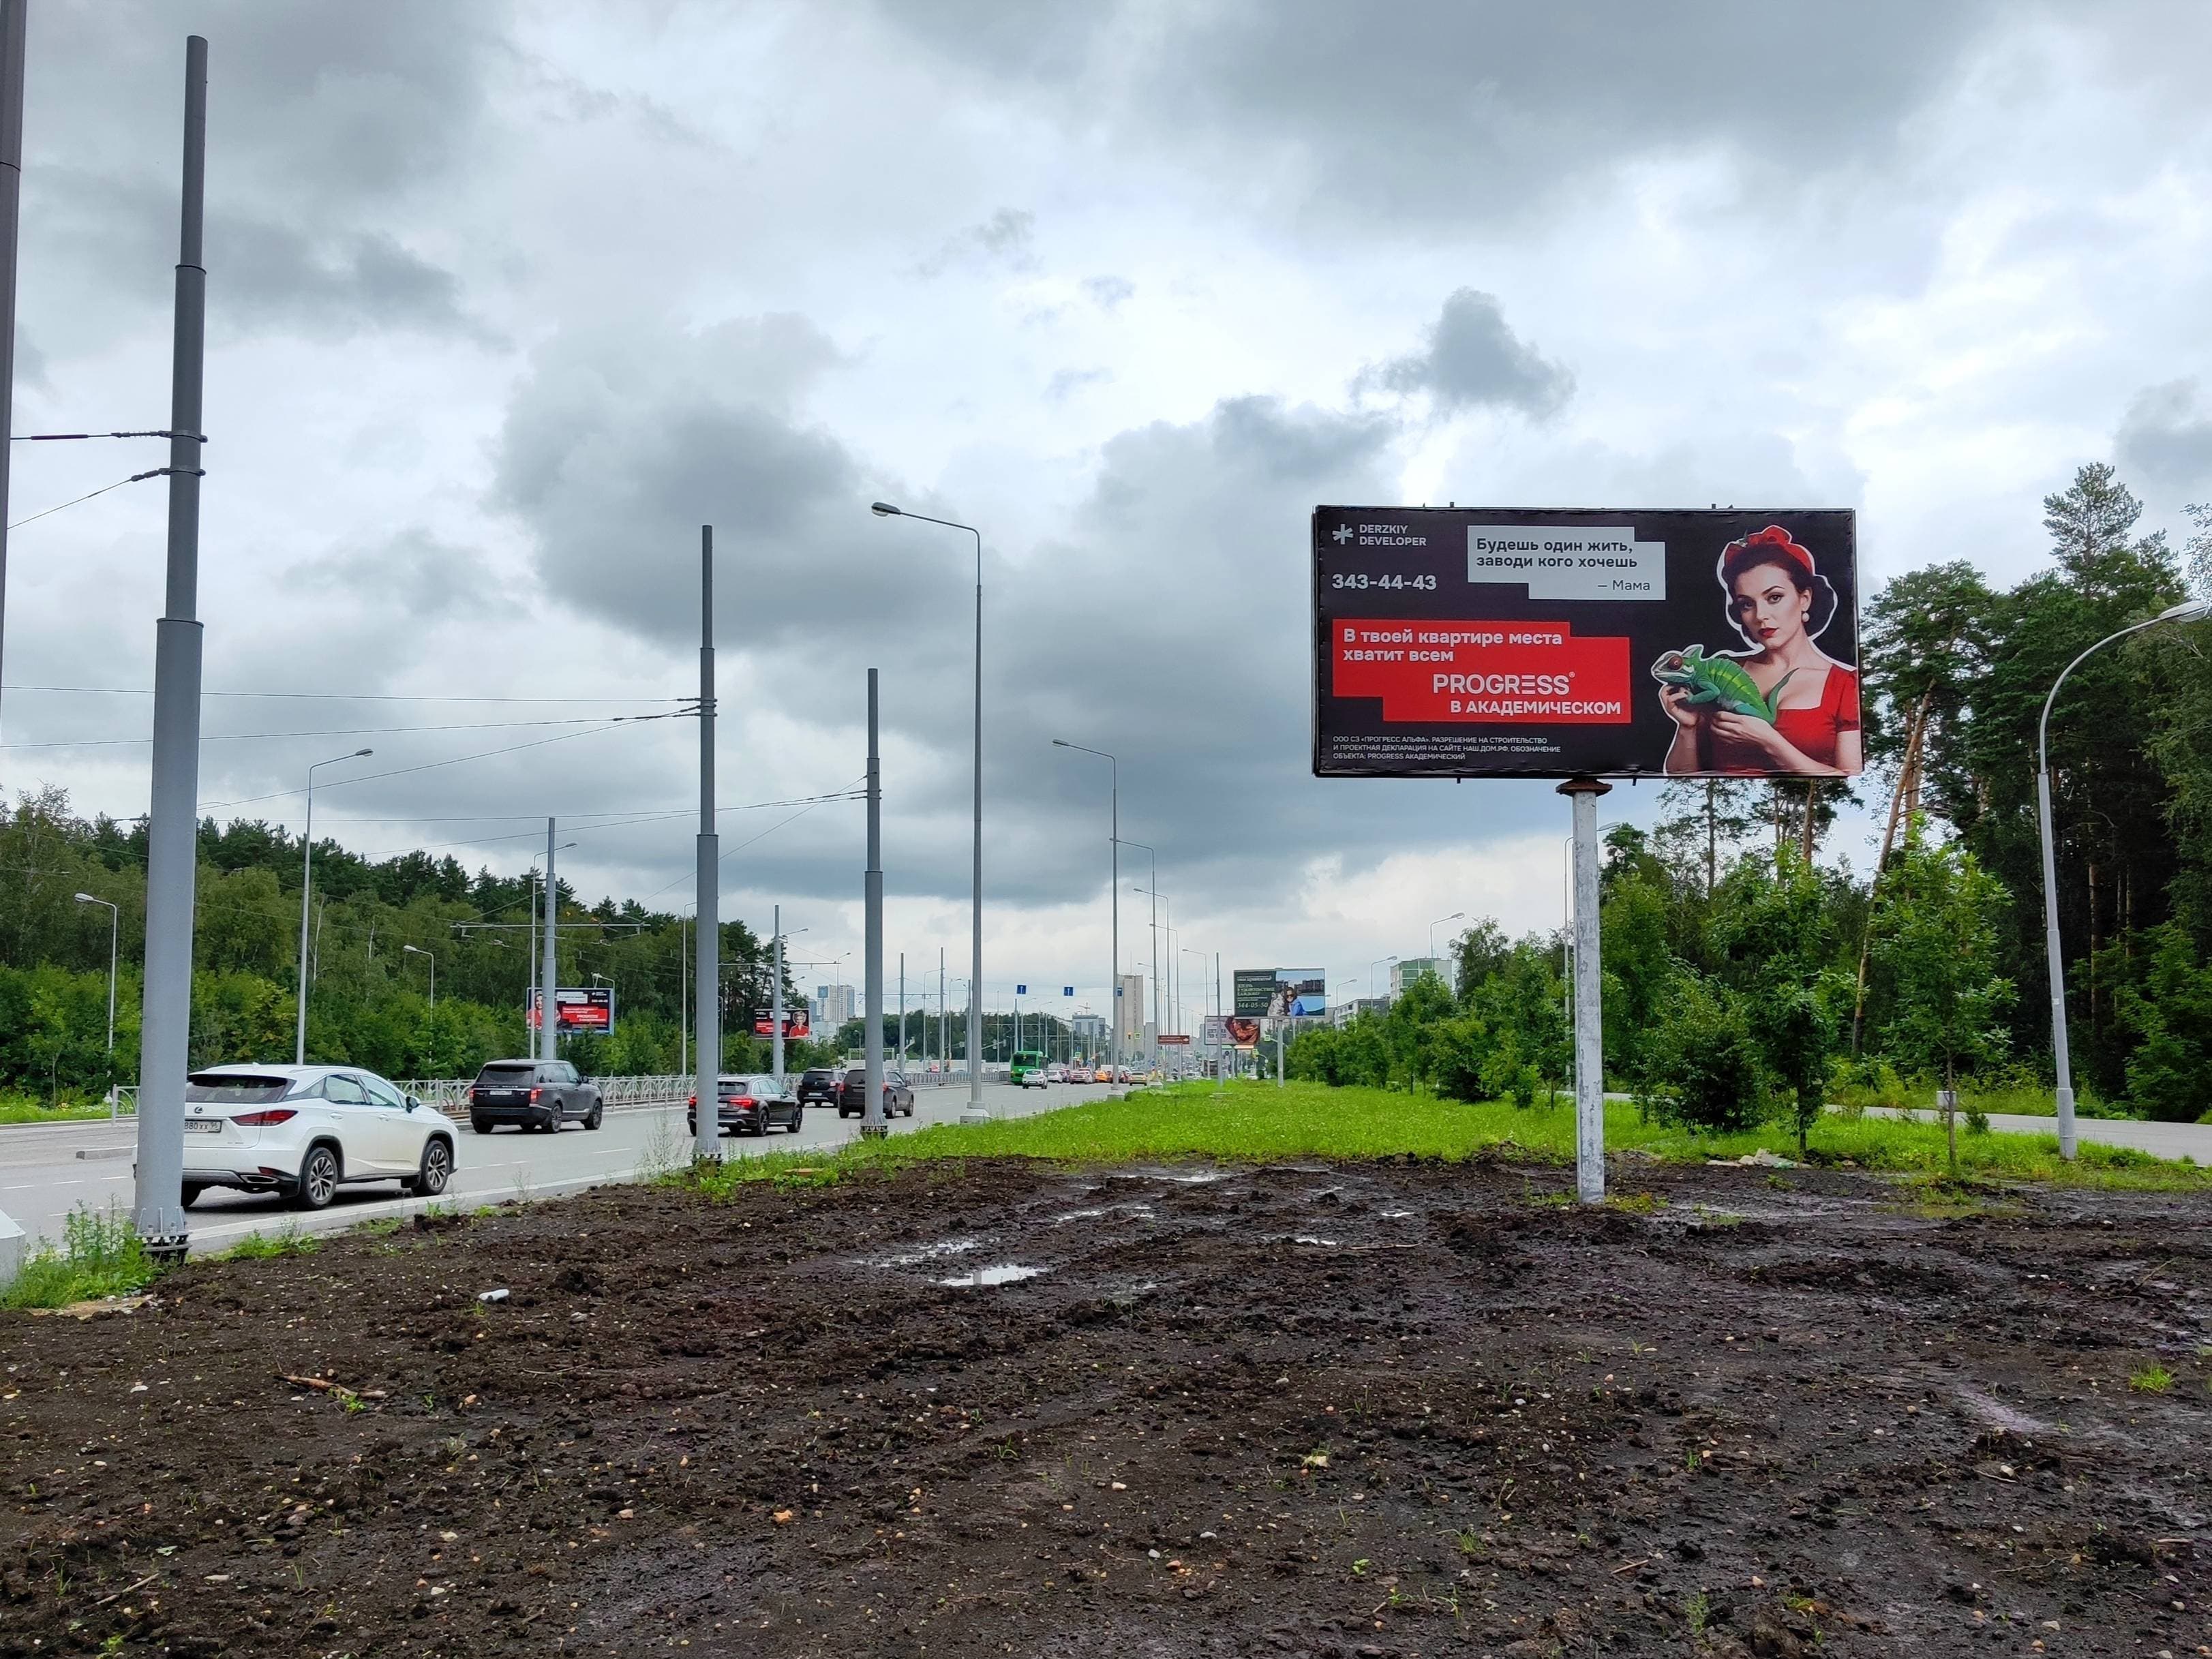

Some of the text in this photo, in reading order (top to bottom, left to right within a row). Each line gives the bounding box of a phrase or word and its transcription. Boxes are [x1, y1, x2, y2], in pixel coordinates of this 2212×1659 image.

[1360, 524, 1408, 534] DERZKIY
[1359, 536, 1427, 546] DEVELOPER
[1476, 538, 1633, 554] Будешь один жить,
[1476, 557, 1637, 568] заводи кого хочешь
[1332, 574, 1437, 590] 343-44-43
[1612, 580, 1650, 590] Мама
[1344, 628, 1562, 648] В твоей квартире места
[1343, 650, 1454, 662] хватит всем
[1451, 701, 1621, 716] В АКАДЕМИЧЕСКОМ
